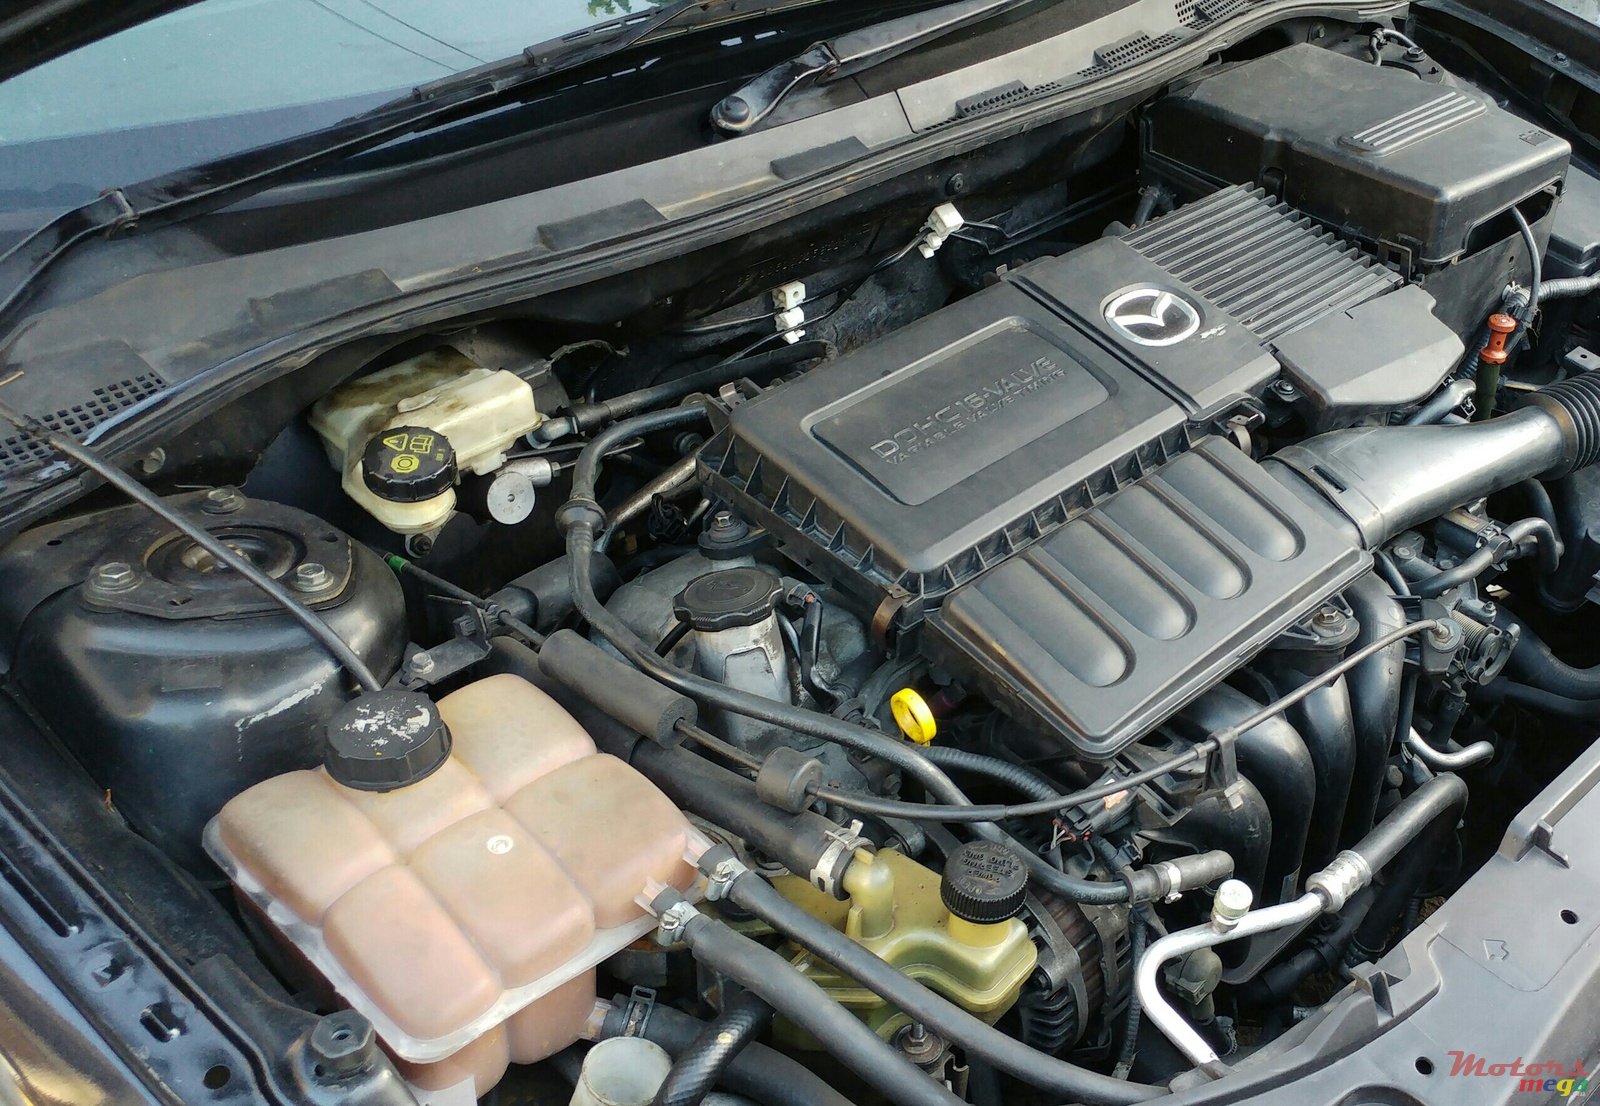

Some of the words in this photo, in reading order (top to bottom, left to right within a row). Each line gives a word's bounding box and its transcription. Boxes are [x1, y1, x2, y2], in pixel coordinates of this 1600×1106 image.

[870, 406, 961, 459] DOHC
[887, 420, 967, 465] VARIABLE
[966, 394, 1016, 423] VALVE
